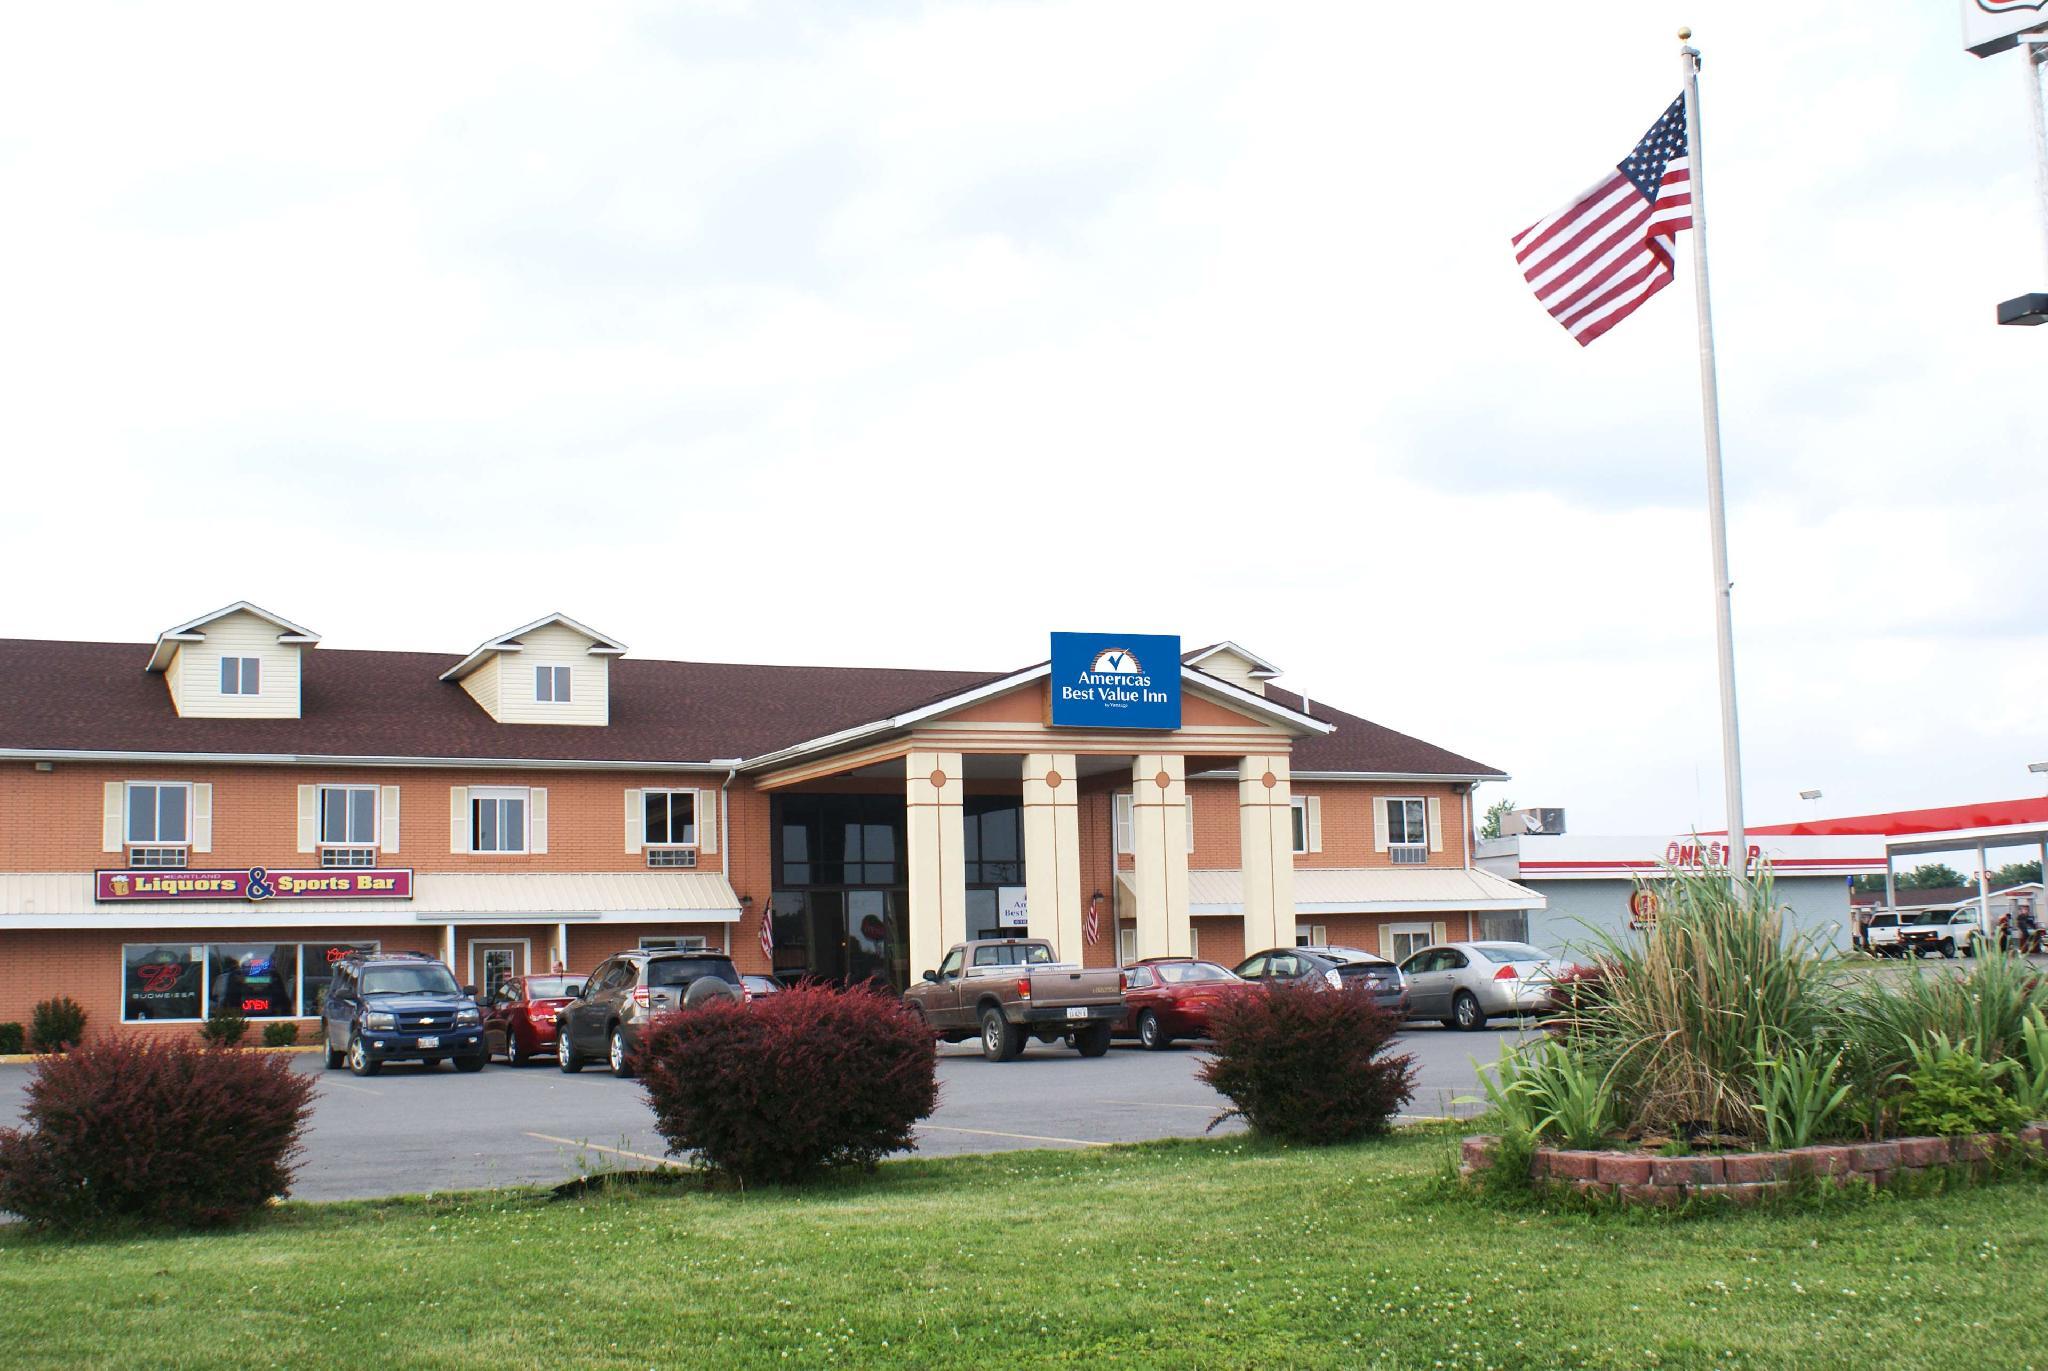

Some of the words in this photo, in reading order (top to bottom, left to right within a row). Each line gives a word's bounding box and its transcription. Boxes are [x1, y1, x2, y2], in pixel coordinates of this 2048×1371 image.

[1078, 671, 1151, 687] Americas
[1062, 686, 1094, 701] Best
[1098, 686, 1139, 702] Value
[1143, 688, 1168, 703] Inn
[1708, 841, 1761, 867] STP
[135, 876, 238, 895] Liquors
[246, 865, 276, 900] &
[277, 875, 351, 893] Sports
[356, 875, 396, 890] Bar
